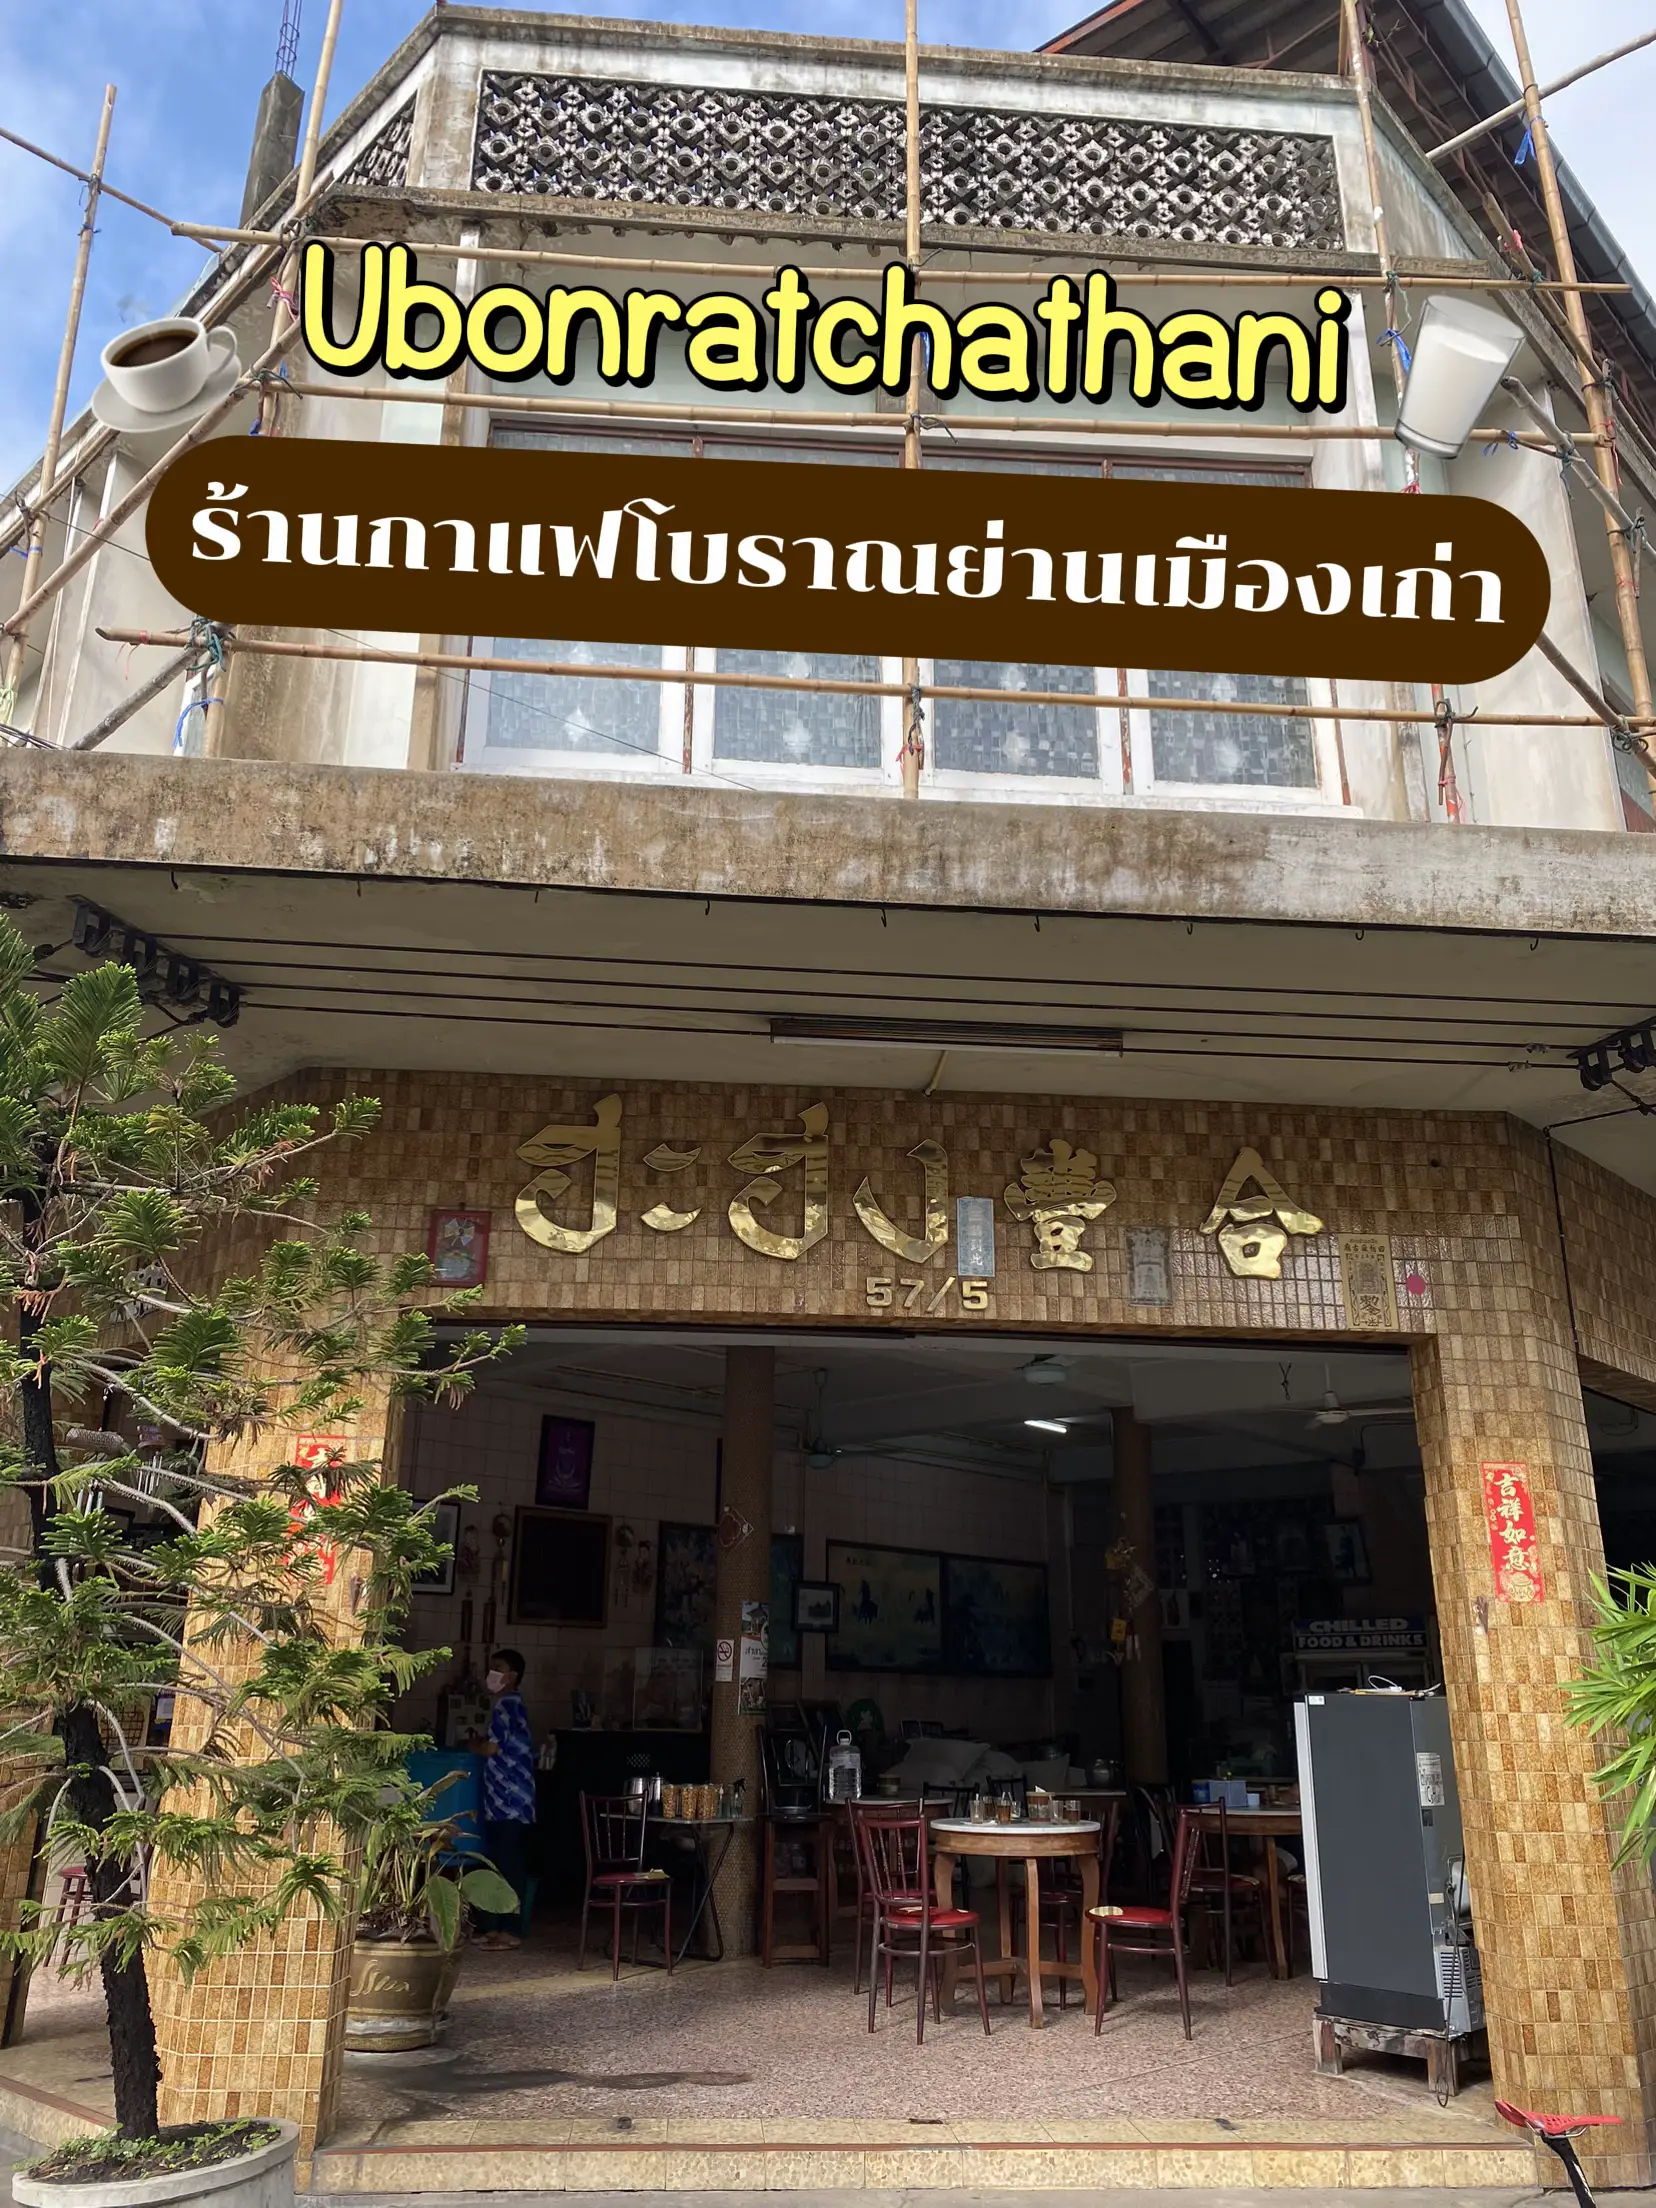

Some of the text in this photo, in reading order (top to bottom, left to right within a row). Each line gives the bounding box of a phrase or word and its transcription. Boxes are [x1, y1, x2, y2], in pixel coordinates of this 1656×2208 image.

[865, 1276, 989, 1313] 57/5
[1494, 1472, 1530, 1571] 吉祥如意
[1308, 1617, 1409, 1633] CHILLED
[1297, 1634, 1424, 1649] FOOD & DRINKS
